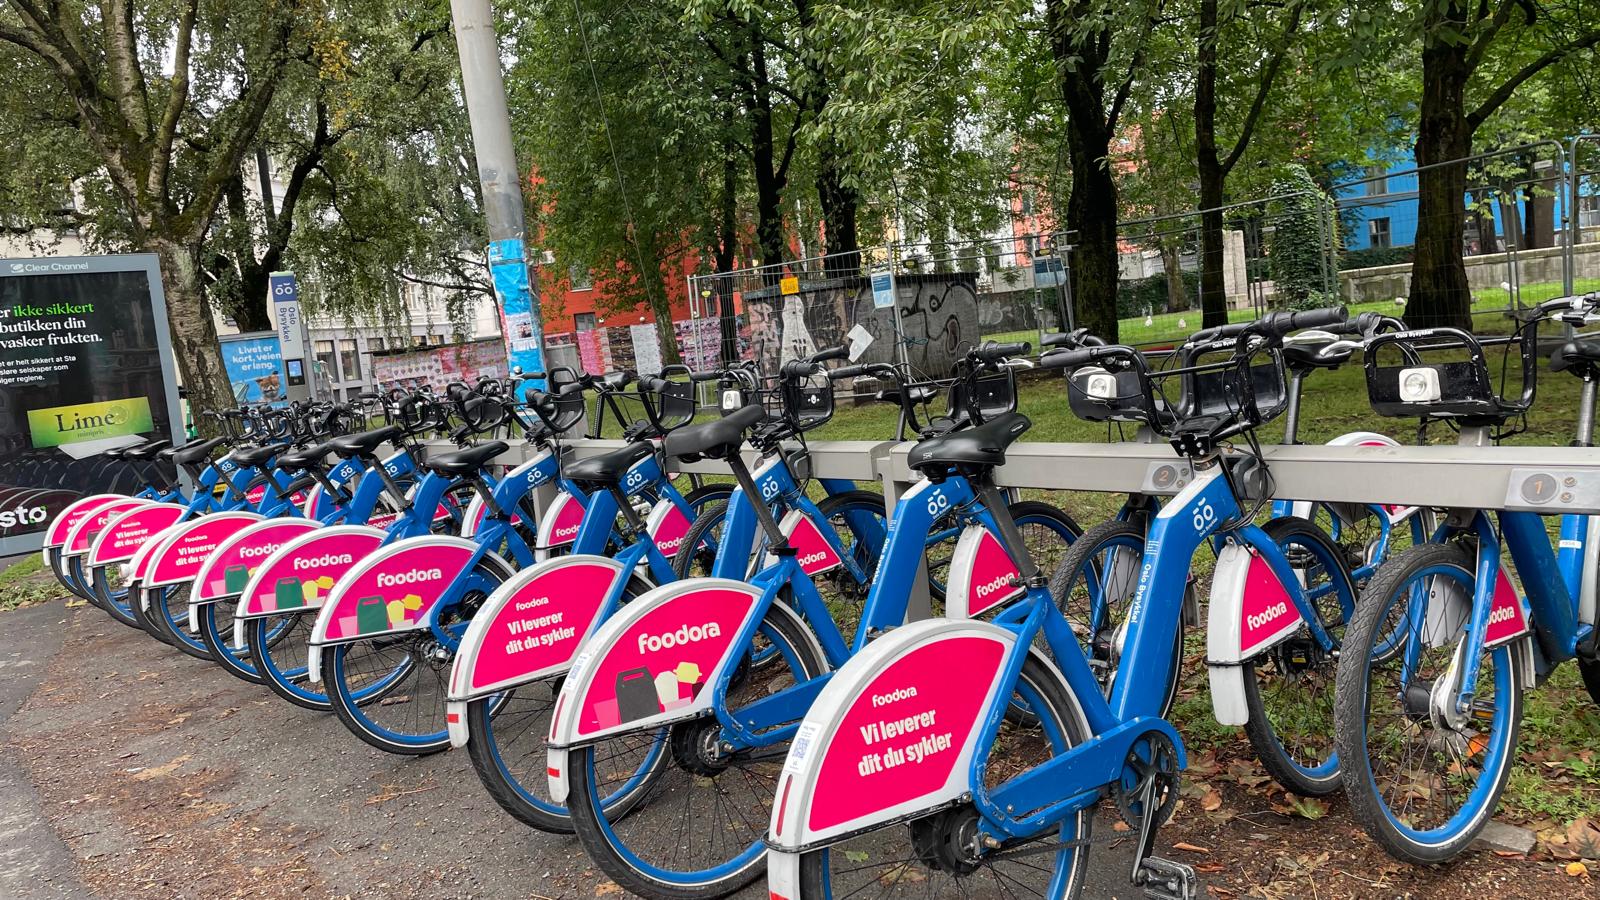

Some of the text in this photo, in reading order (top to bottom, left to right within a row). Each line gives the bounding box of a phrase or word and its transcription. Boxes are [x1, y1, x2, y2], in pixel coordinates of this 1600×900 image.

[25, 262, 88, 272] Clear Channel
[13, 304, 44, 317] ikke
[46, 303, 95, 315] sikkert
[287, 306, 296, 325] Oslo
[0, 317, 87, 334] butikken din
[279, 307, 292, 342] Bysykkel
[0, 332, 103, 349] vasker frukten.
[232, 352, 281, 364] kort, veien
[238, 346, 262, 355] Livet
[31, 357, 55, 365] sikkert
[252, 361, 276, 371] lang.
[19, 366, 52, 374] selskaper
[16, 375, 46, 383] reglene.
[54, 412, 116, 433] Lime
[1158, 470, 1169, 482] 2
[1534, 480, 1543, 494] 1
[178, 543, 217, 556] Vi leverer
[175, 557, 188, 566] dit
[188, 556, 199, 564] du
[293, 553, 353, 571] foodora
[798, 551, 828, 567] odora
[377, 568, 442, 588] foodora
[1130, 563, 1152, 623] Oslo Bysykkel
[515, 596, 550, 612] foodora
[506, 611, 564, 635] Vi leverer
[1246, 601, 1288, 632] foodora
[1488, 605, 1516, 625] odora
[505, 626, 576, 655] dit du sykler
[637, 621, 721, 655] foodora
[872, 686, 918, 708] foodora
[859, 709, 937, 746] Vi leverer
[857, 731, 953, 777] dit du sykler
